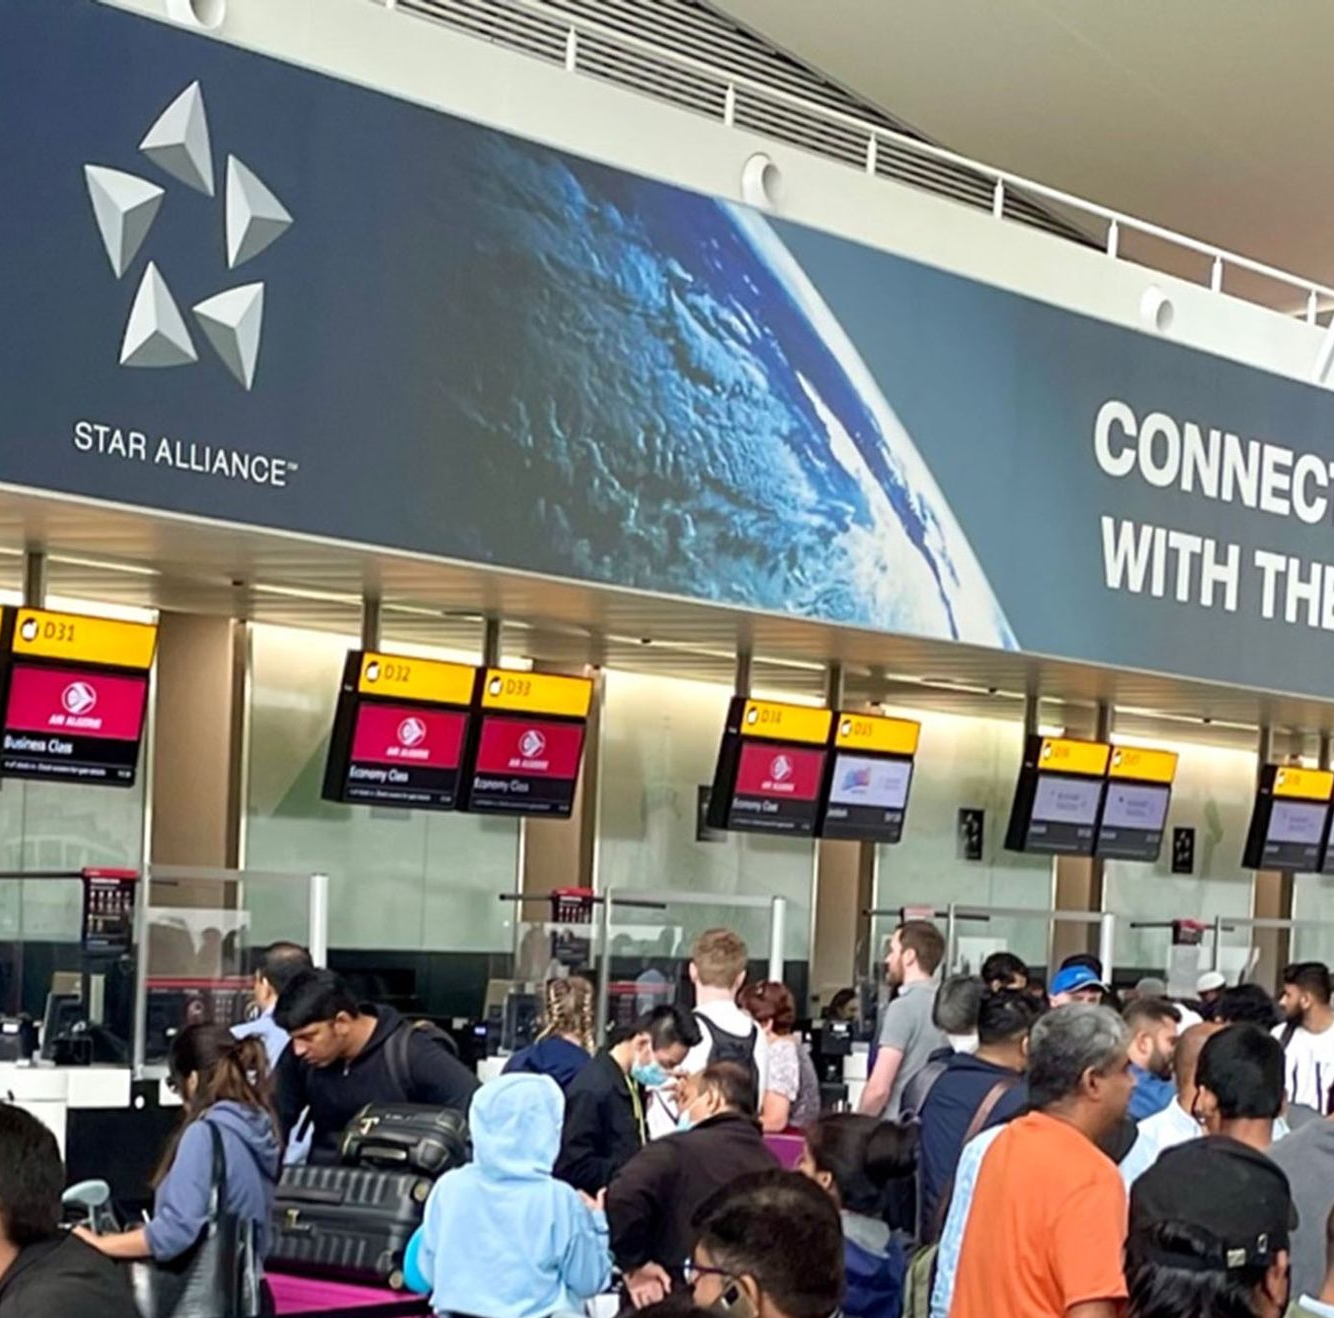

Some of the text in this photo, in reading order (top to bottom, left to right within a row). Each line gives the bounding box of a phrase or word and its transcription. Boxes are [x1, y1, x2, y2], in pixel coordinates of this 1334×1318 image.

[74, 421, 147, 461] STAR
[1101, 516, 1240, 612] WITH
[43, 620, 75, 642] D31
[384, 666, 411, 682] D32
[506, 680, 531, 696] D33
[3, 735, 73, 755] Business Class
